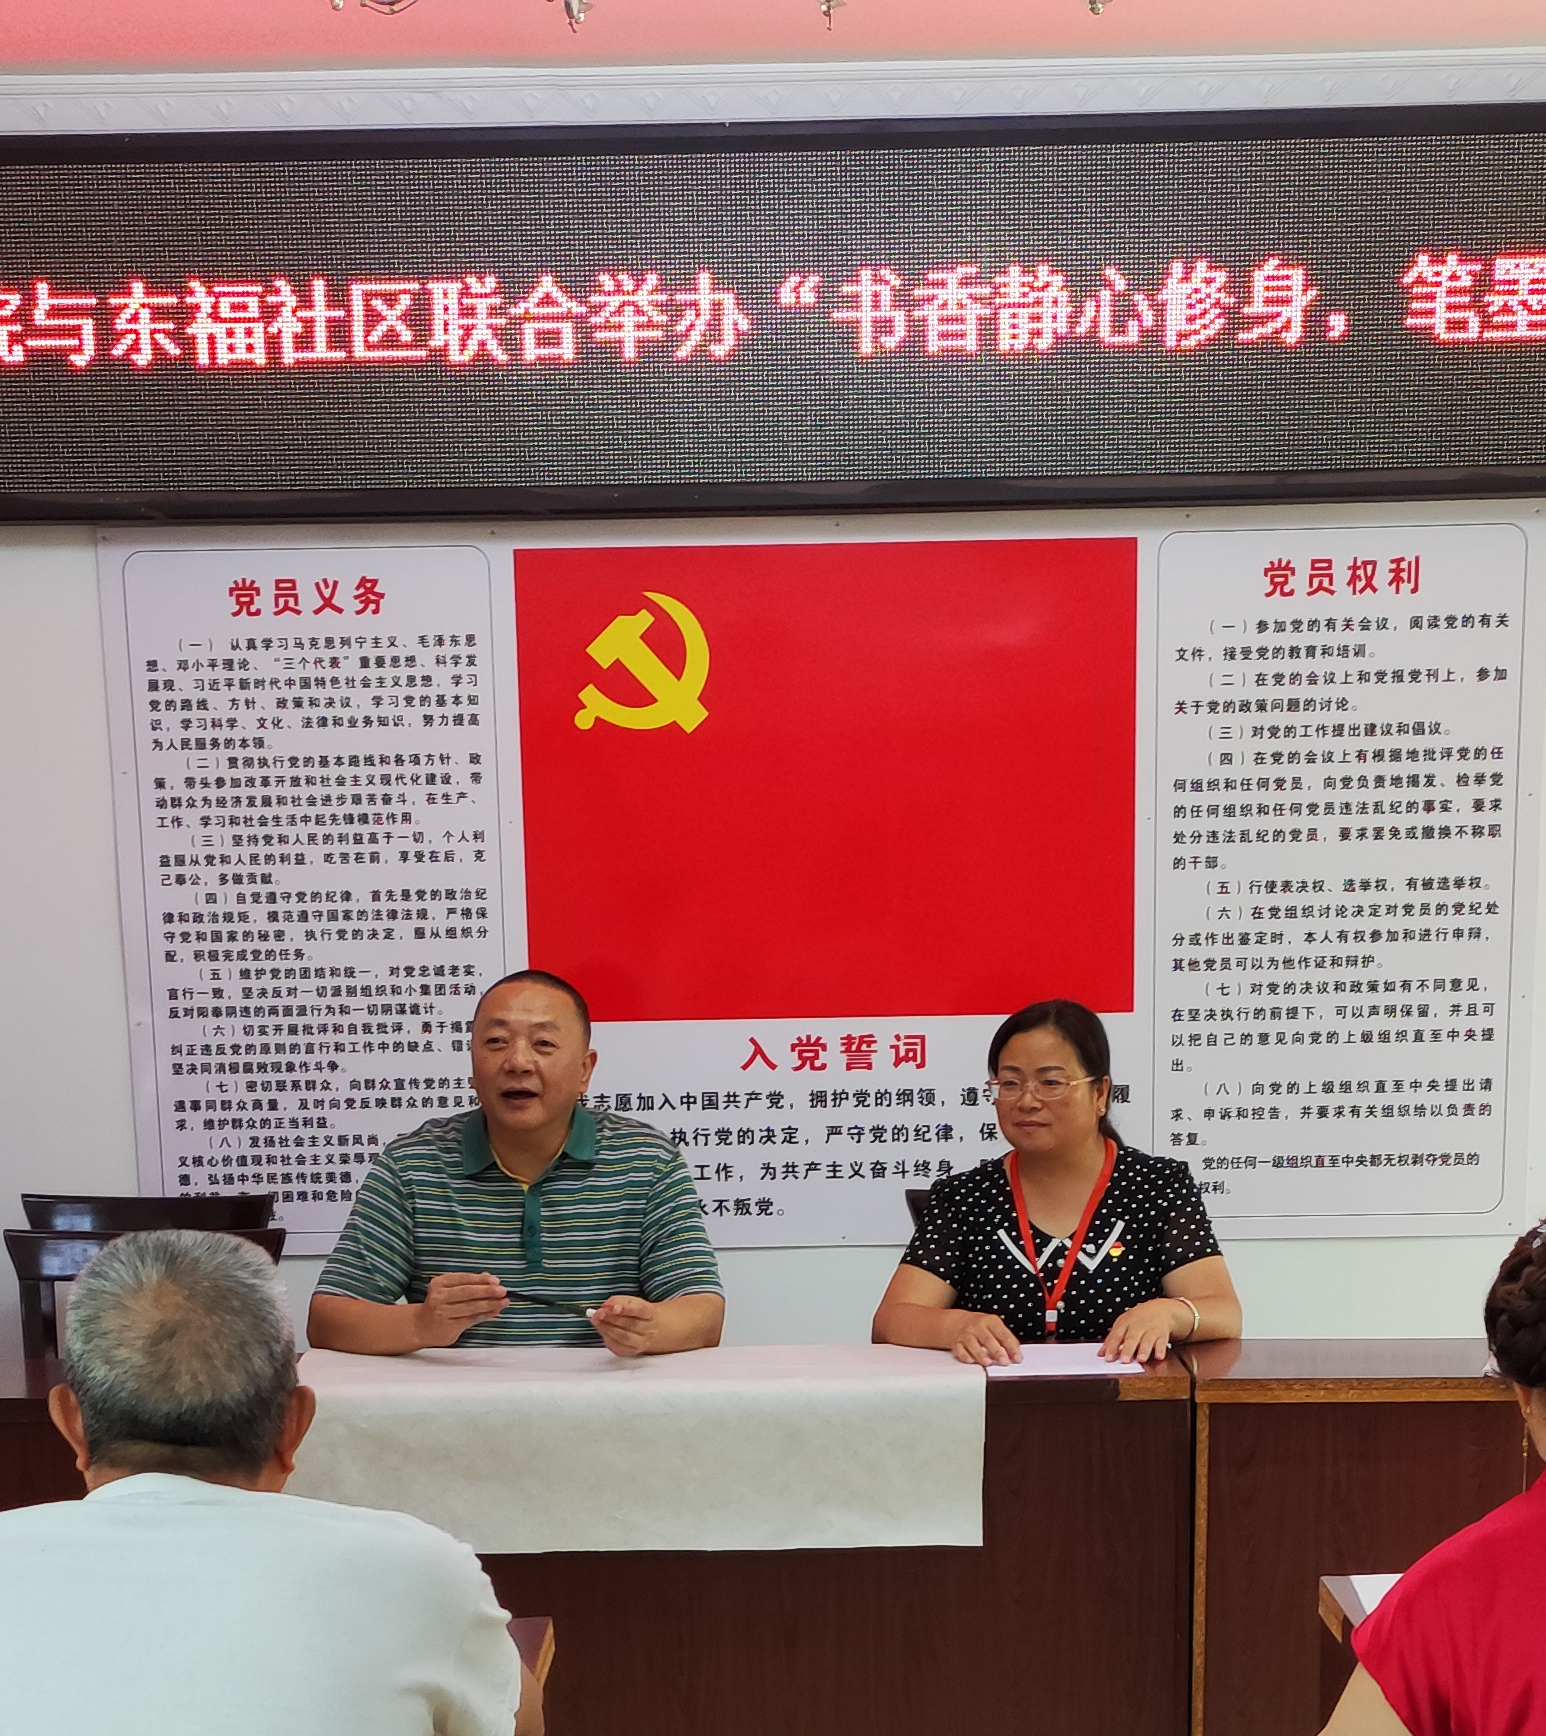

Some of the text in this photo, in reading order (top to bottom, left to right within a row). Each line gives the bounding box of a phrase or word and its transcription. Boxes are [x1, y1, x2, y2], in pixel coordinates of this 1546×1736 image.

[229, 576, 386, 617] 党员义务
[1264, 555, 1420, 598] 党员权利
[740, 1033, 926, 1072] 入党誓词
